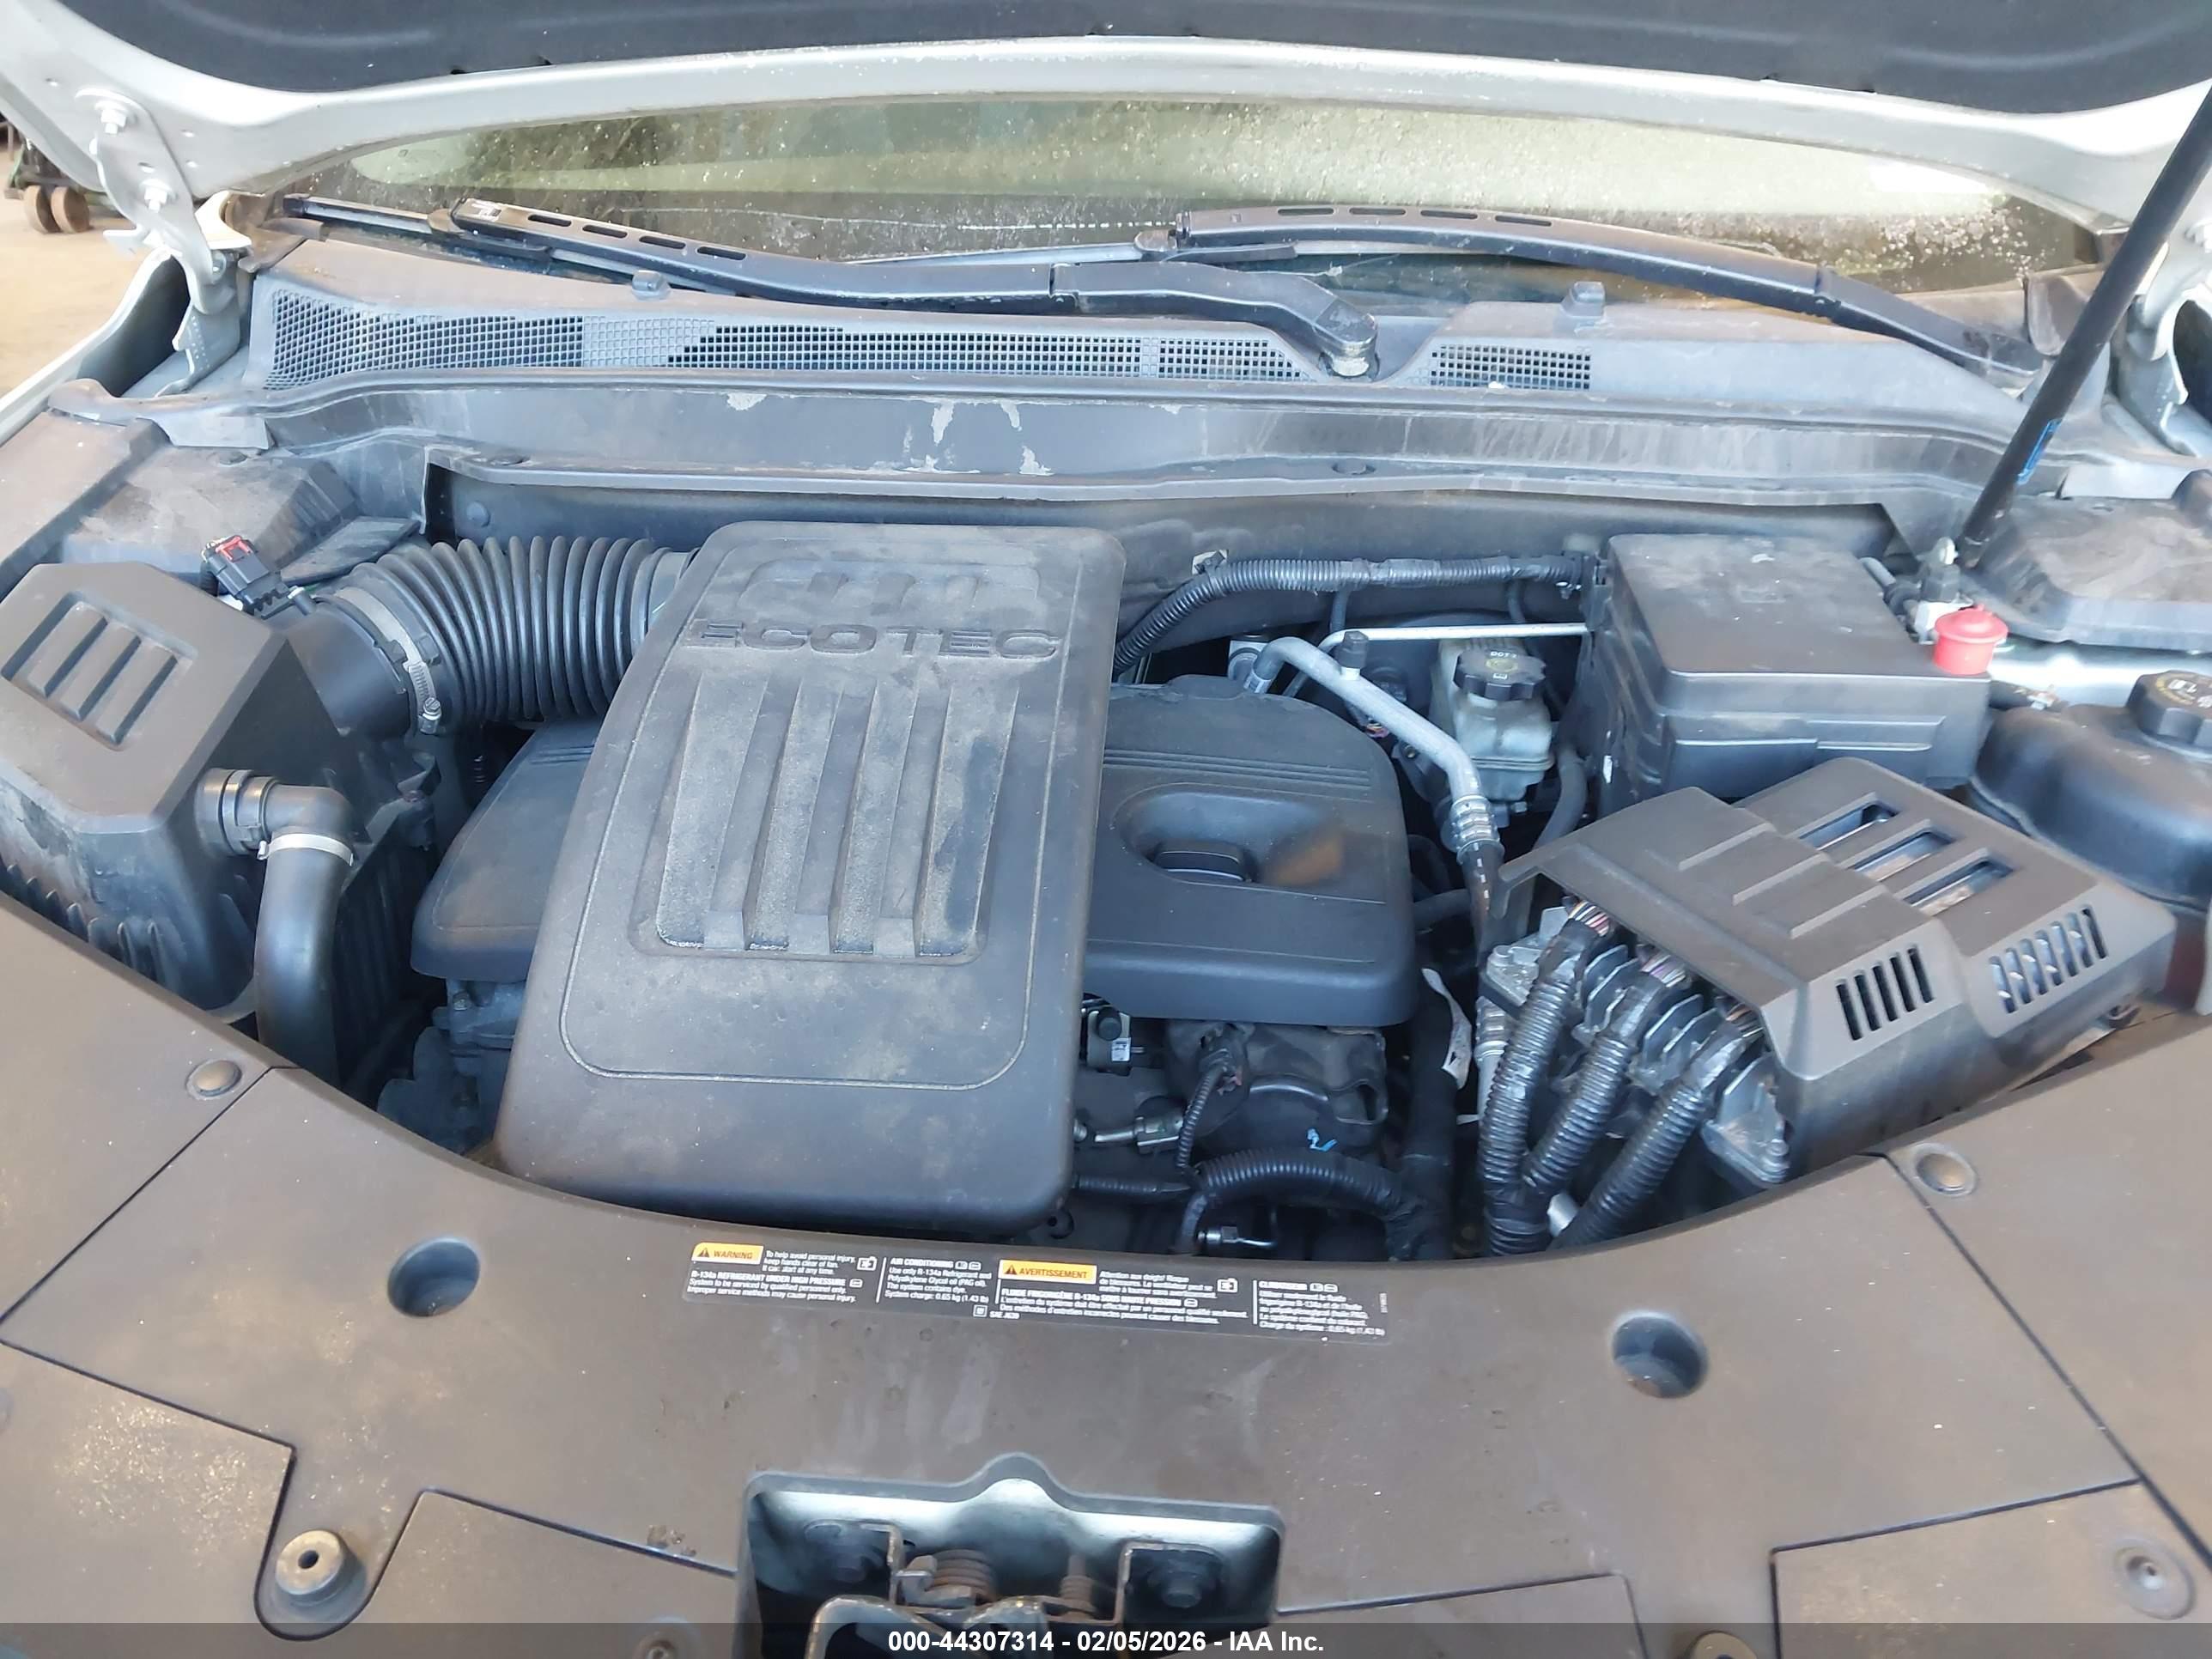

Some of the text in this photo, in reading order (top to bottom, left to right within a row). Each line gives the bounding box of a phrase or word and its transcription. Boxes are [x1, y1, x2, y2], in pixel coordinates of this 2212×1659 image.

[687, 619, 1062, 660] ECOTEC
[714, 1250, 752, 1259] WARNING
[904, 1259, 953, 1268] CONDITIONING
[1019, 1267, 1087, 1279] AVERTISSEMENT
[689, 1278, 714, 1286] System
[717, 1272, 766, 1282] REFRIGERANT
[765, 1274, 790, 1283] UNDER
[809, 1276, 846, 1286] PRESSURE
[884, 1290, 908, 1298] System
[1101, 1294, 1120, 1303] SOUS
[1146, 1297, 1182, 1307] PRESSION
